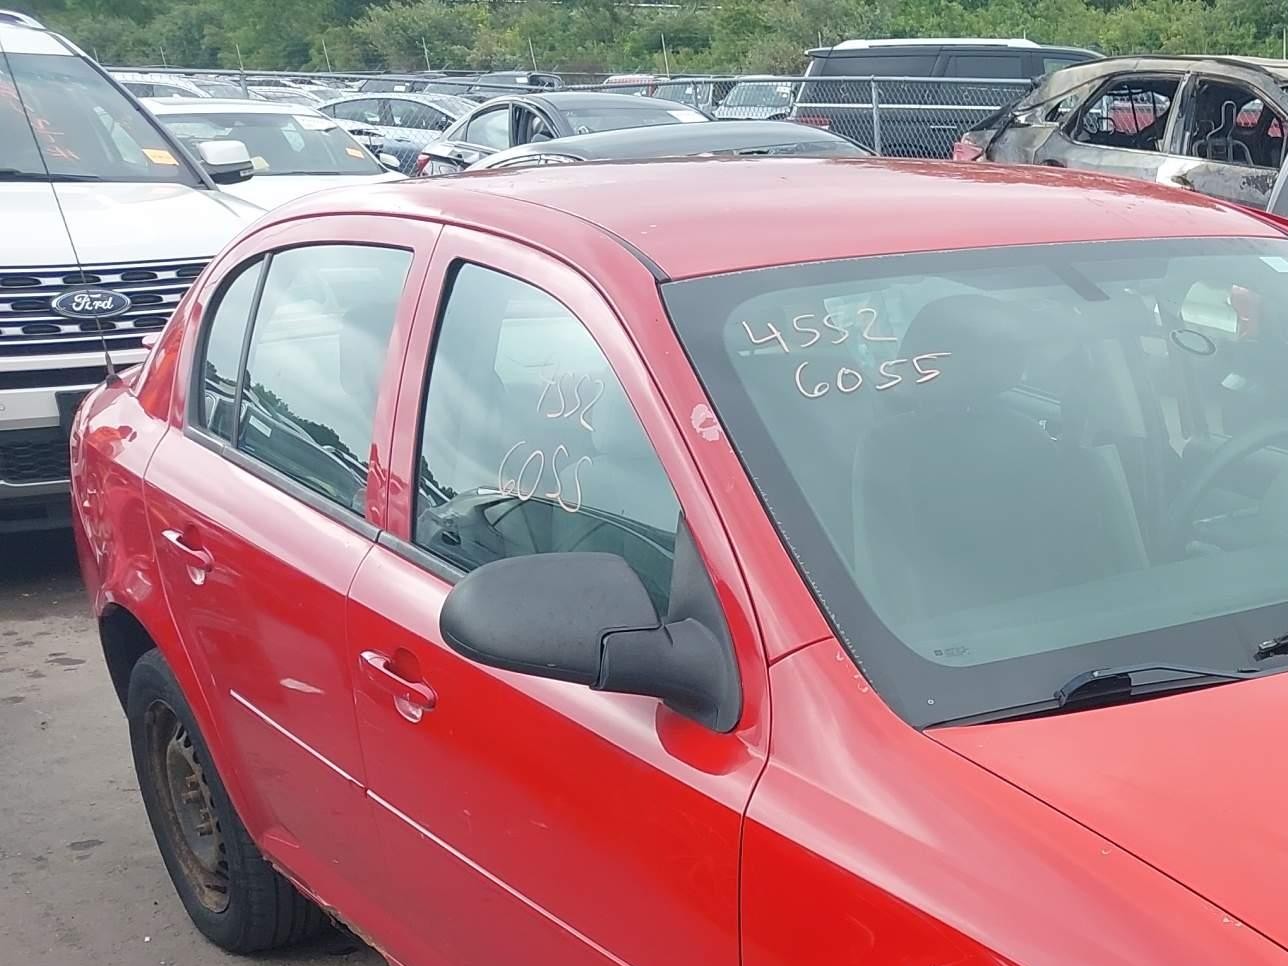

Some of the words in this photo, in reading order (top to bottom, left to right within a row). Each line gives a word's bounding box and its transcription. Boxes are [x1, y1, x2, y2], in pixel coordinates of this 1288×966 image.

[72, 294, 114, 311] Ford
[742, 308, 899, 353] 4552
[795, 352, 953, 398] 6055
[498, 440, 594, 513] 6055
